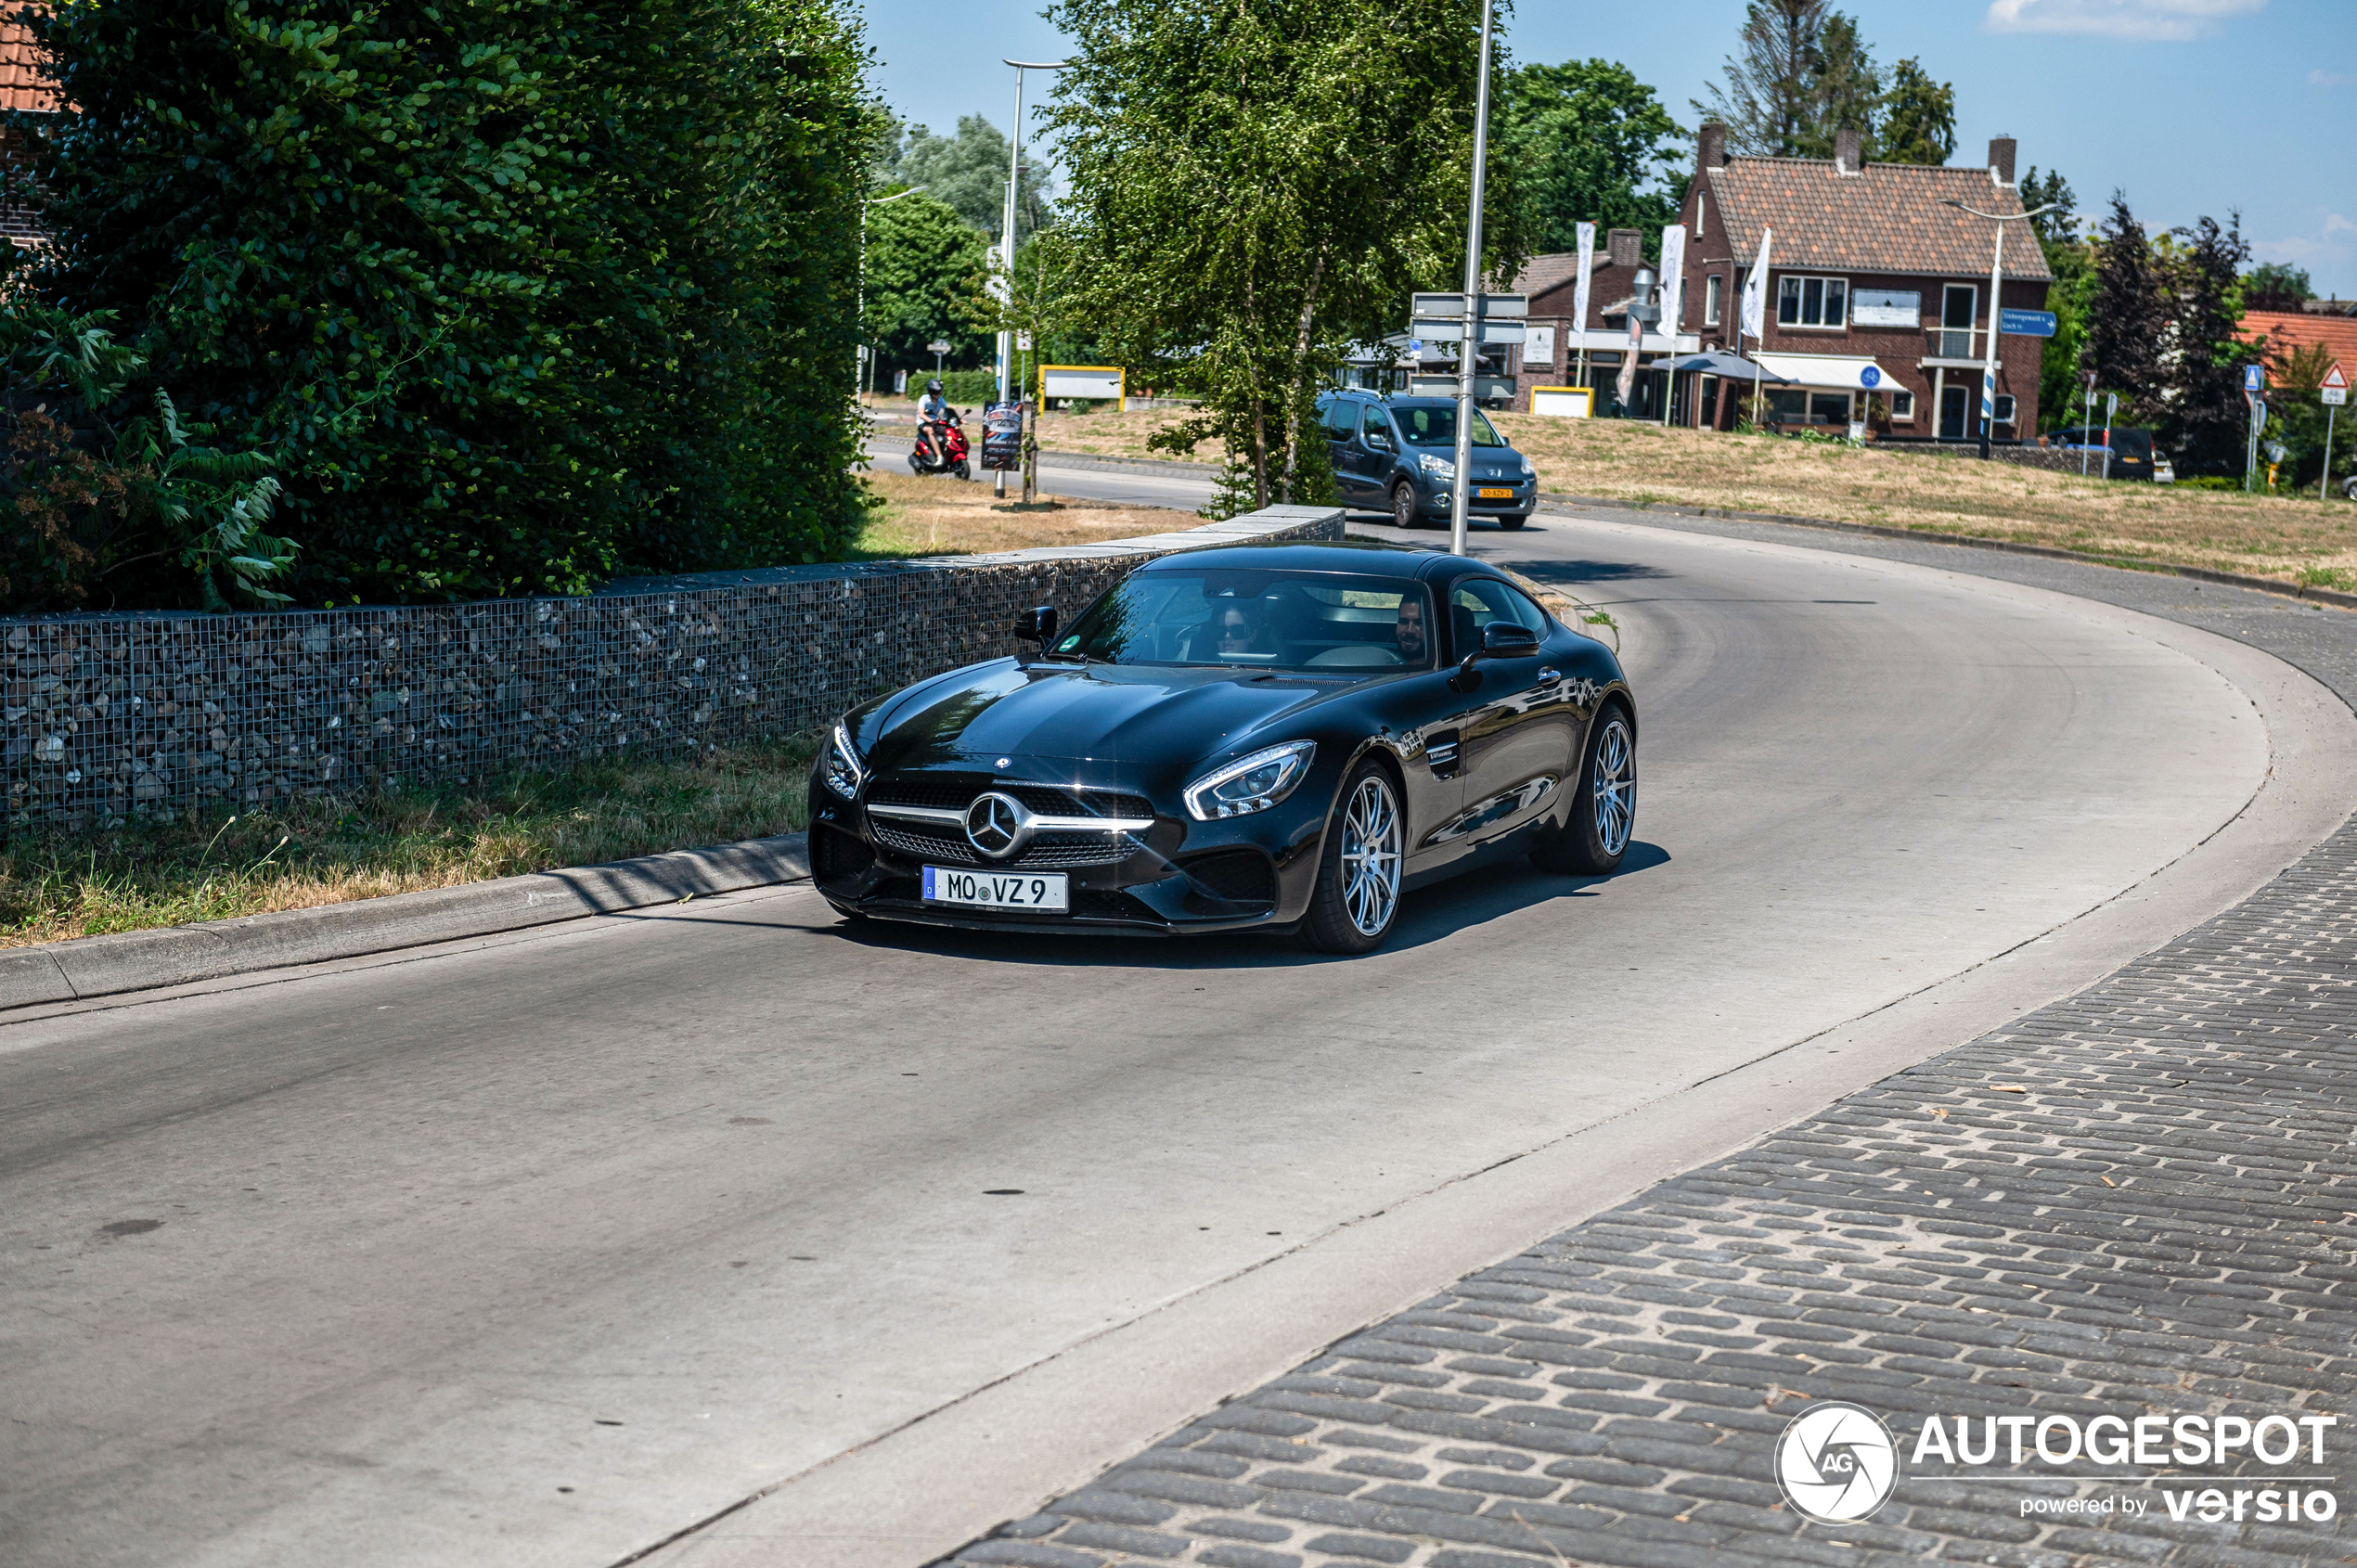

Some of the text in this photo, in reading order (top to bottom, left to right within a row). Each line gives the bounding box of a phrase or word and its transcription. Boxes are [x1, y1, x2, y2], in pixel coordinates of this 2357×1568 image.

[927, 886, 933, 894] D
[947, 873, 1046, 904] MO VZ 9
